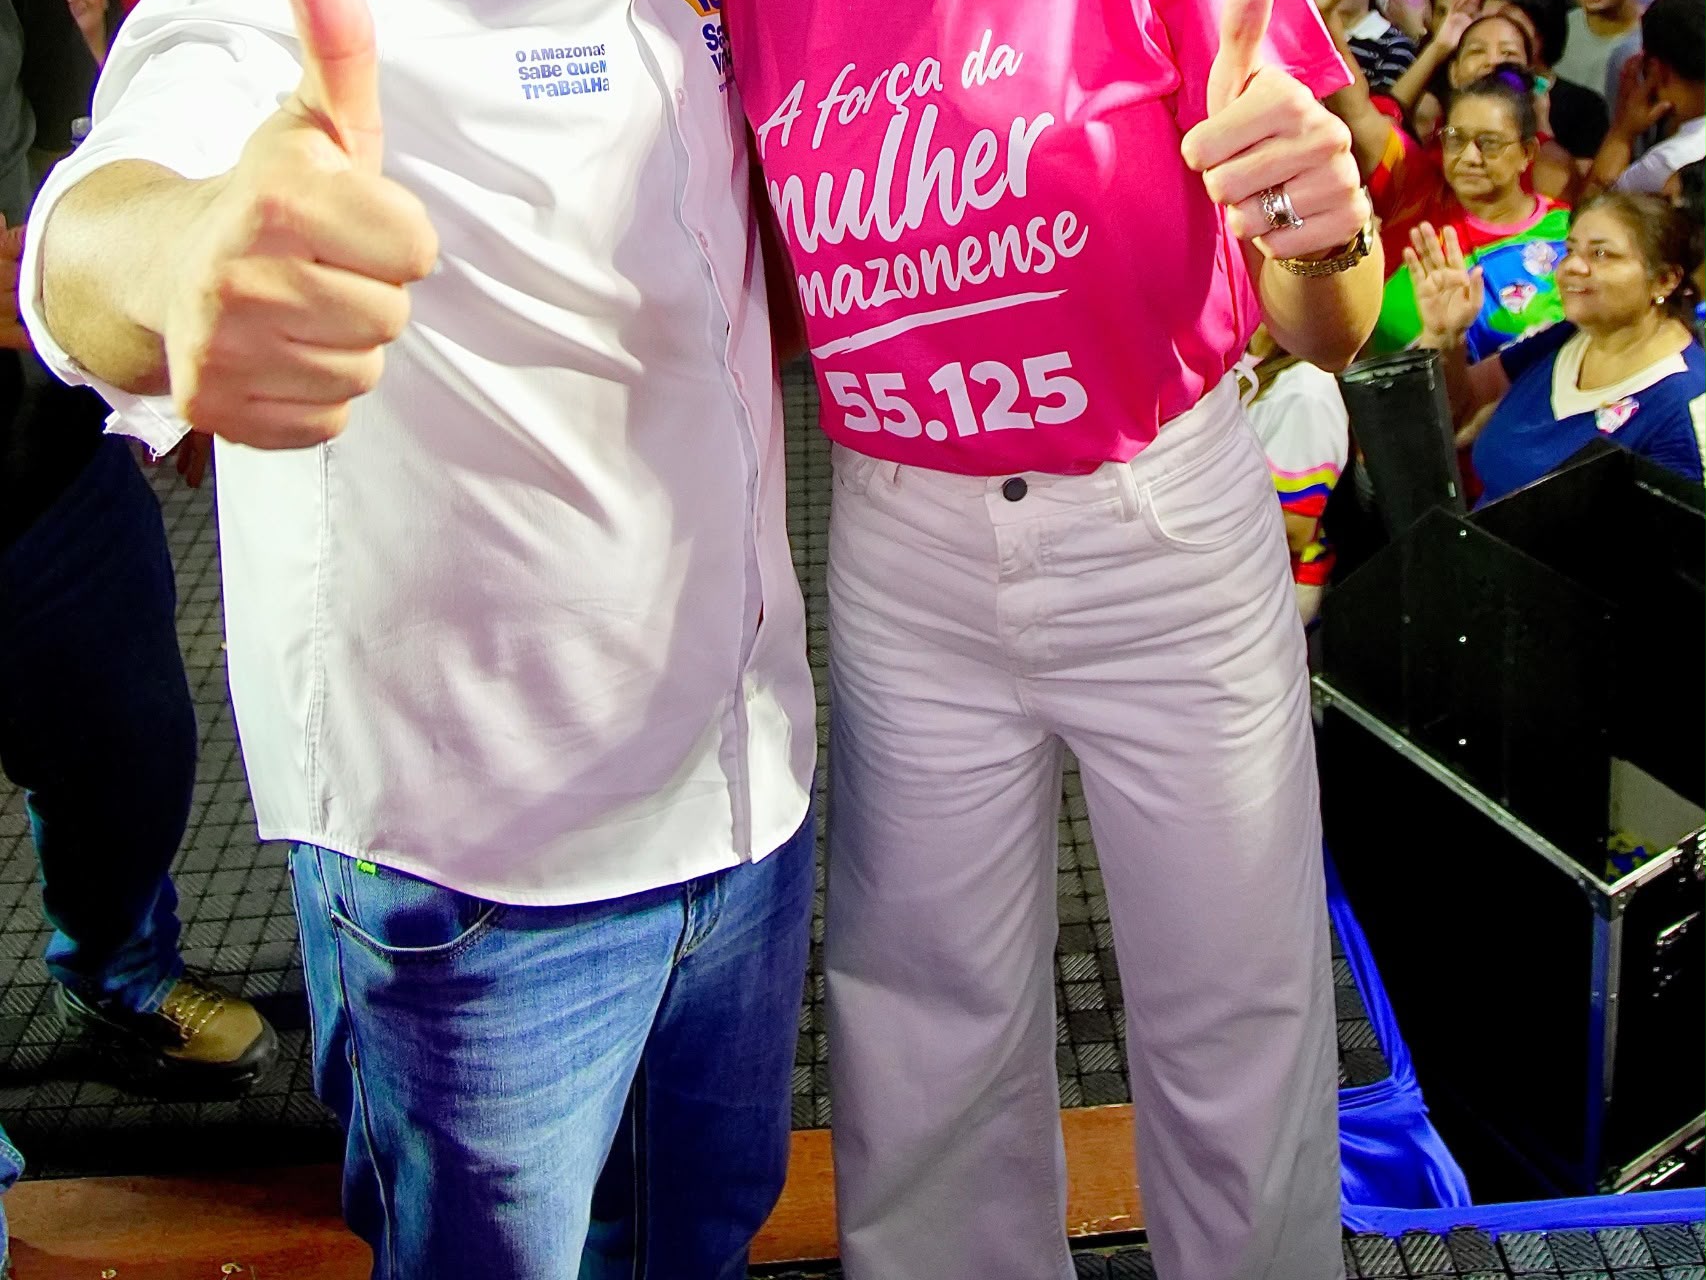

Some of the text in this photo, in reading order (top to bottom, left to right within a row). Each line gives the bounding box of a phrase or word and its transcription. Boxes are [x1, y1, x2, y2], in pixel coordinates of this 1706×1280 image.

[515, 50, 527, 63] O
[757, 29, 1023, 160] A força da
[765, 104, 1055, 253] mulher
[798, 210, 1089, 319] mazonense
[823, 351, 1089, 441] 55.125
